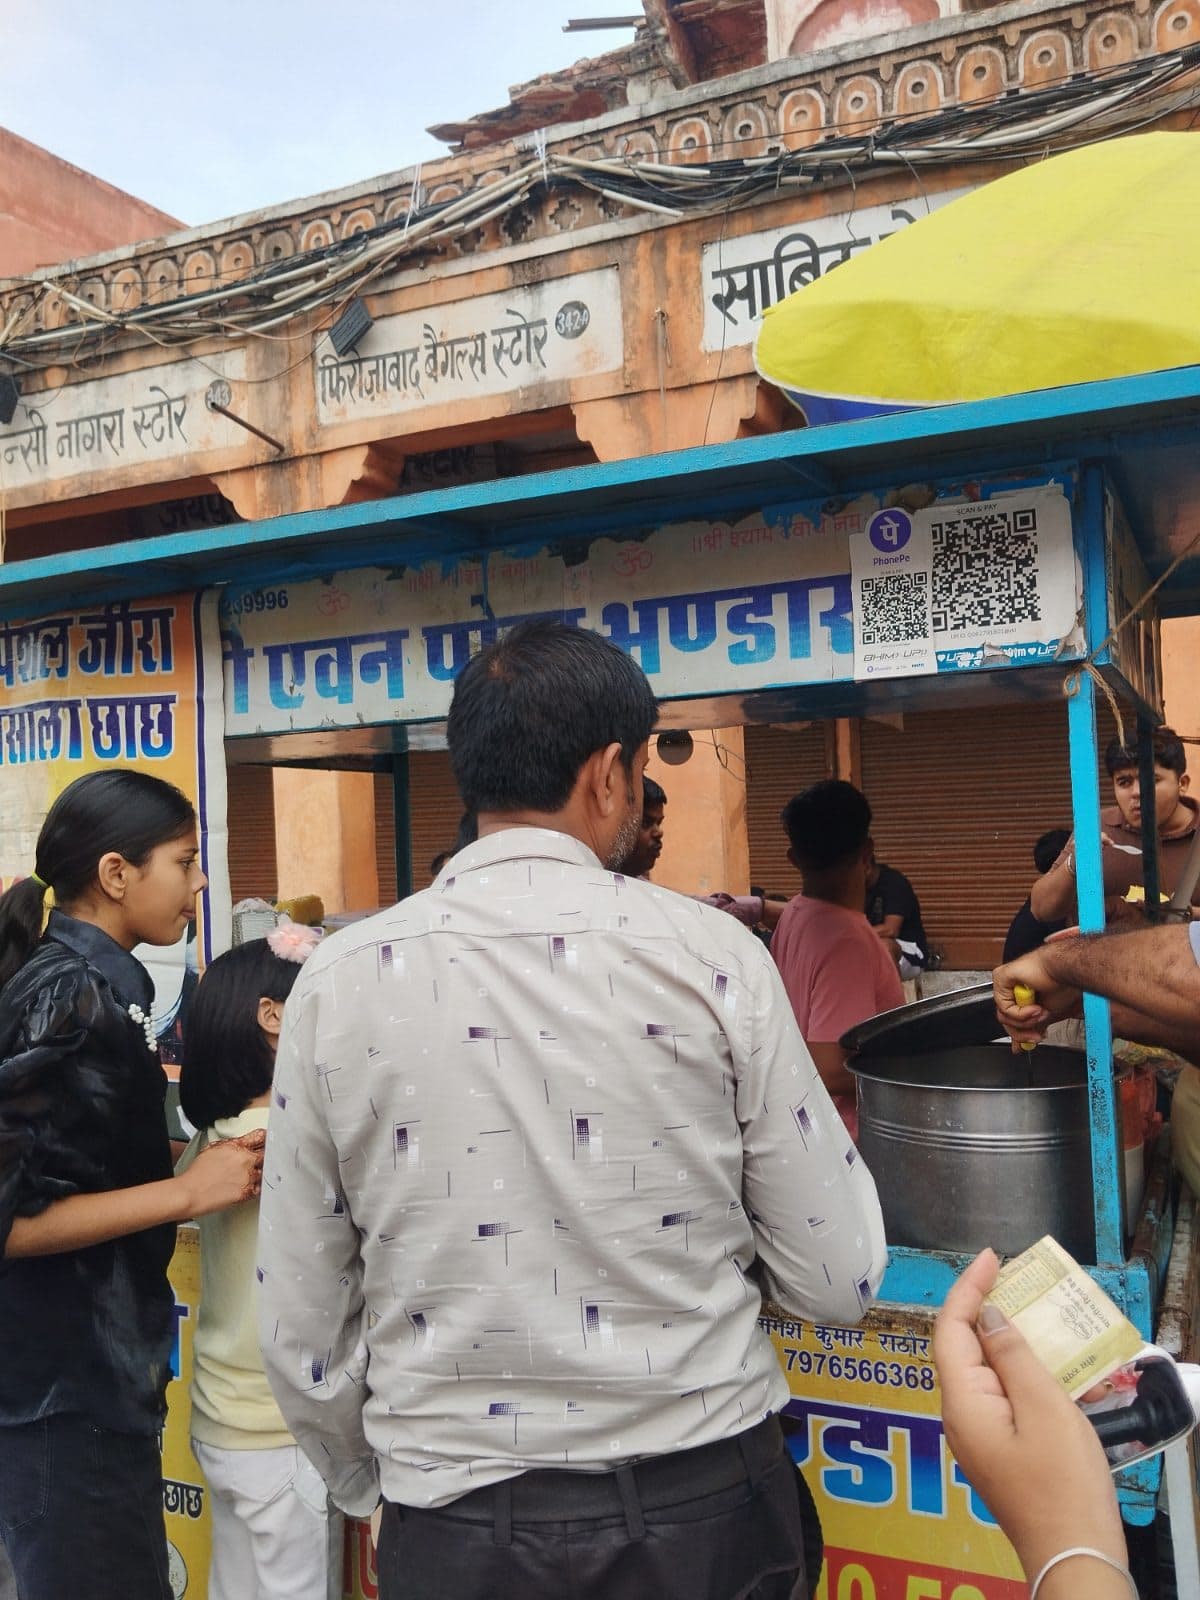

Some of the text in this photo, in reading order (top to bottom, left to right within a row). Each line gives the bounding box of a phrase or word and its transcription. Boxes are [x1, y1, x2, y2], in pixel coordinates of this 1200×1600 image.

[491, 308, 549, 379] स्टोर
[0, 386, 188, 473] न्सी नागरा स्टोर
[872, 554, 911, 567] PhonePe
[262, 629, 410, 710] एवन
[0, 692, 178, 766] साला छाछ
[783, 1348, 935, 1391] 7976566368
[814, 1324, 866, 1351] कुमार
[878, 1329, 931, 1357] राठौर
